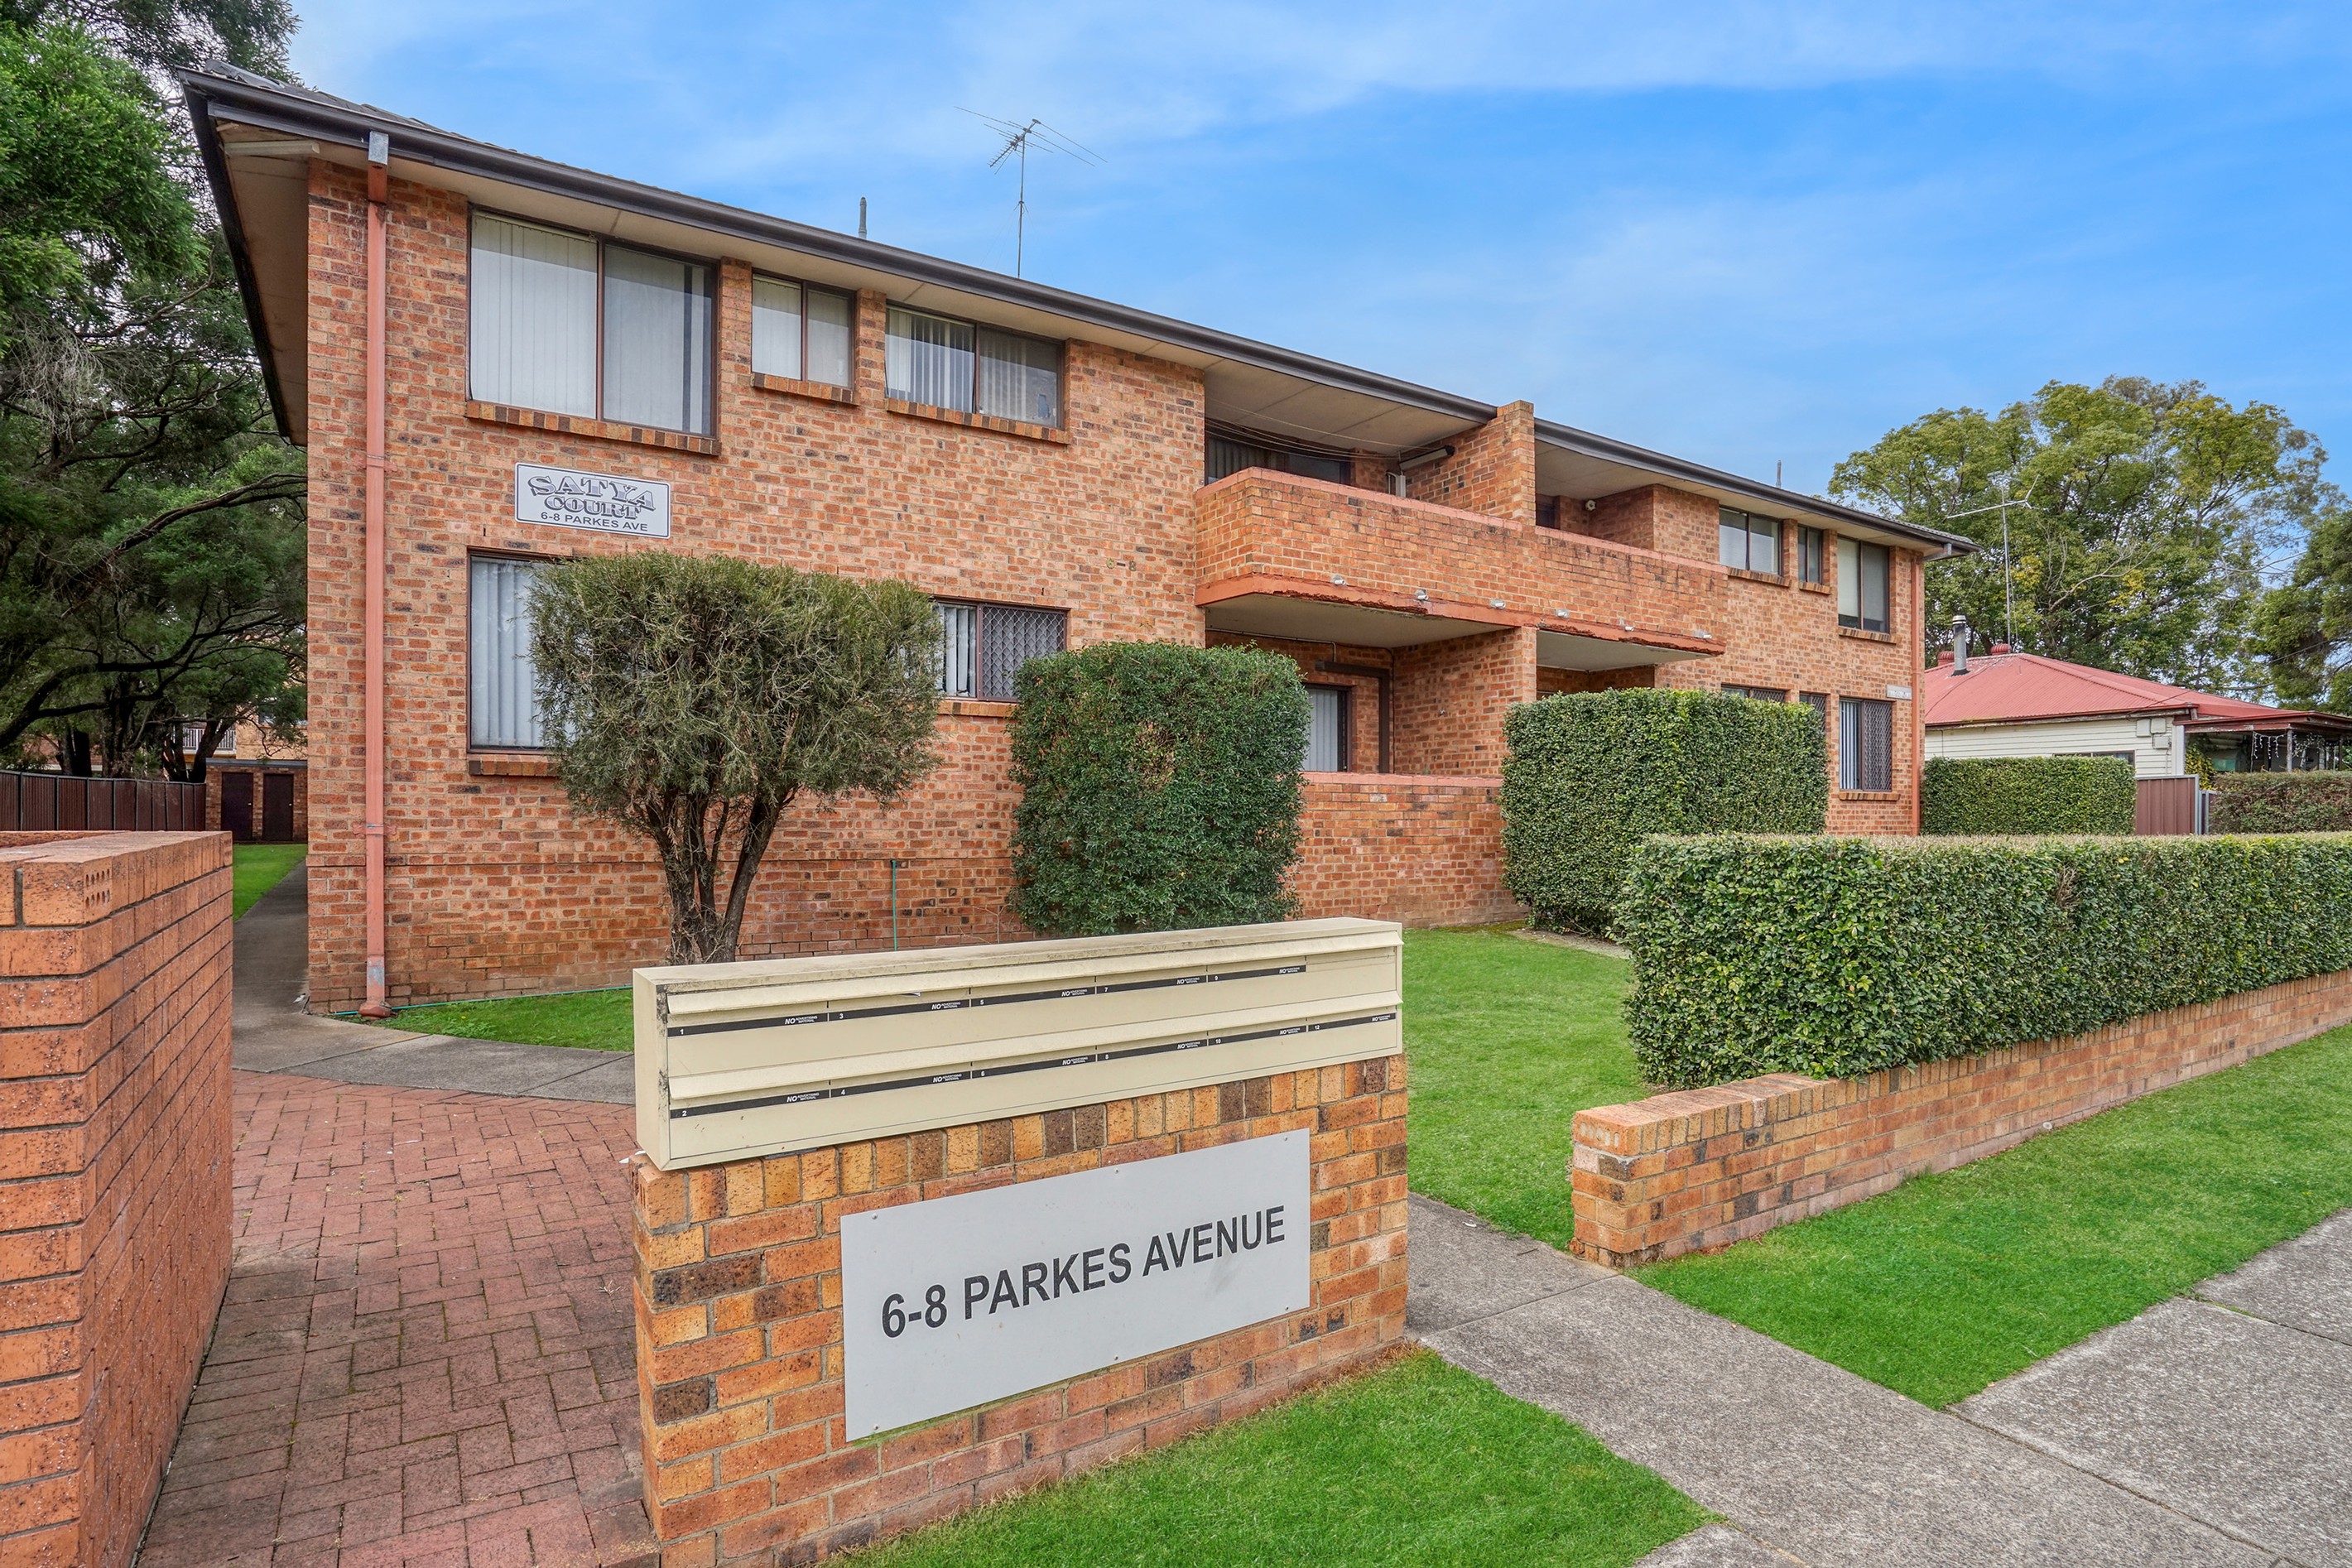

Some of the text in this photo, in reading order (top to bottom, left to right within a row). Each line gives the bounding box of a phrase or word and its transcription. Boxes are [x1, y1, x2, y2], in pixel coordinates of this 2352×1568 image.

[528, 476, 656, 511] SATYA
[545, 495, 642, 519] COURT
[541, 512, 648, 531] 6-8 PARKES AVE
[881, 1205, 1286, 1339] 6-8 PARKES AVENUE
